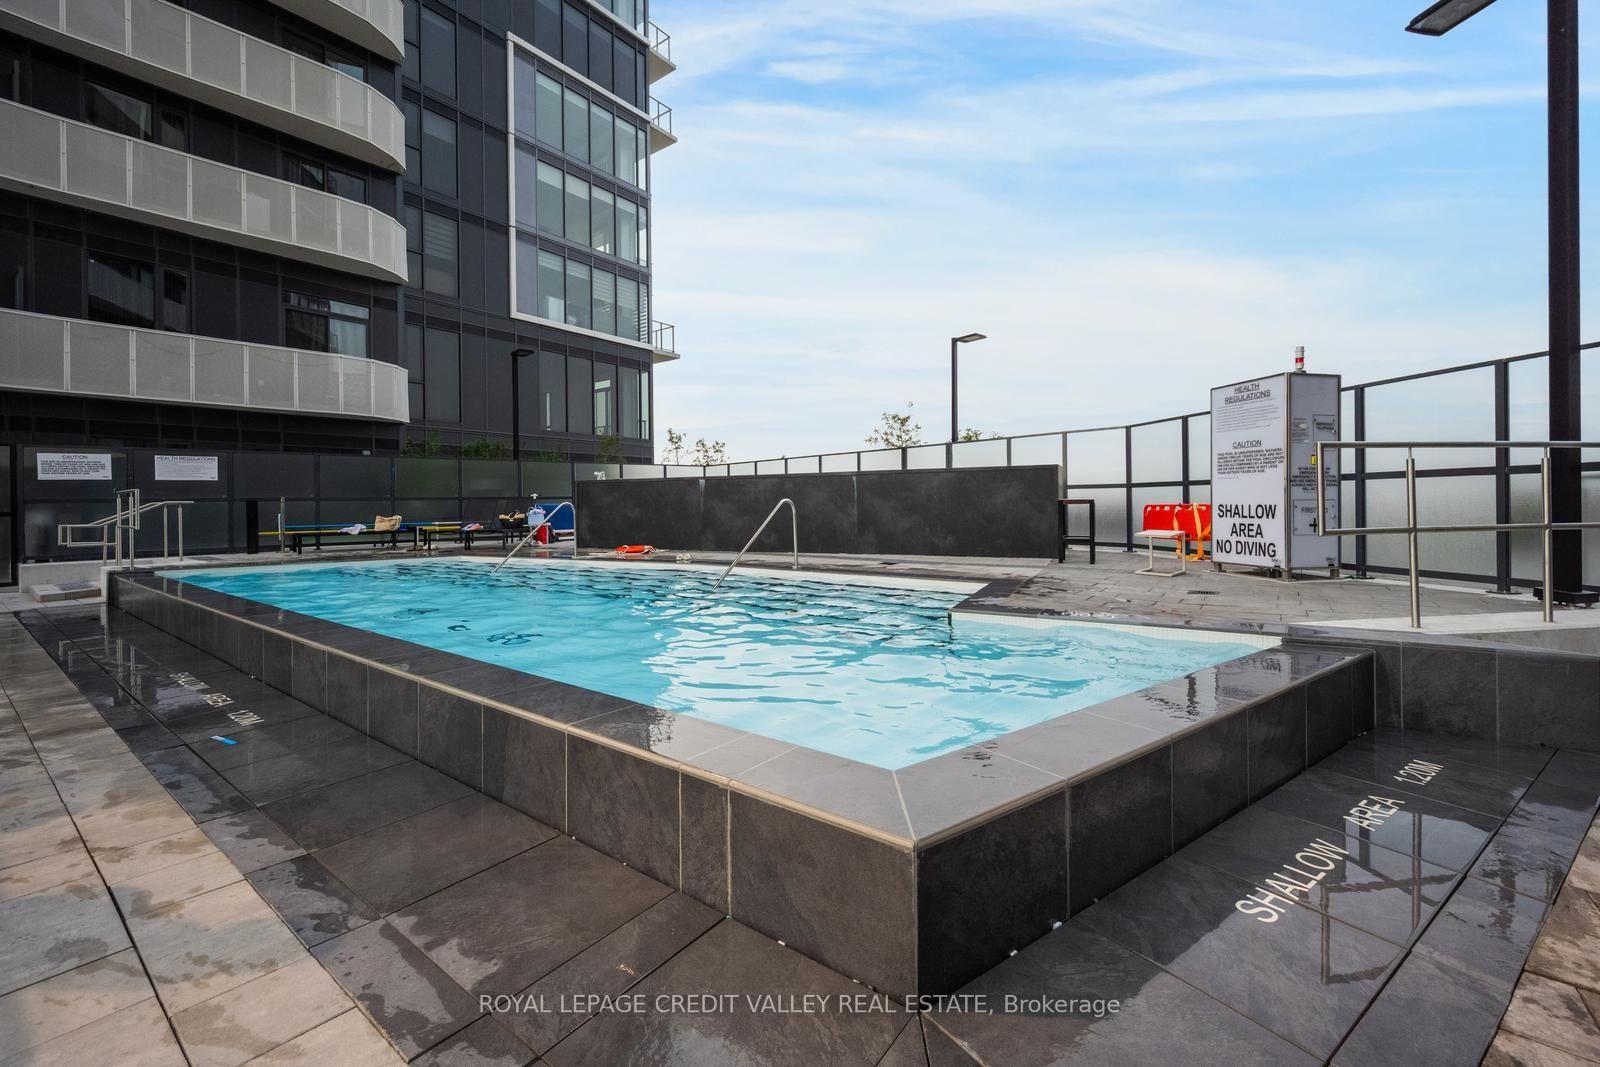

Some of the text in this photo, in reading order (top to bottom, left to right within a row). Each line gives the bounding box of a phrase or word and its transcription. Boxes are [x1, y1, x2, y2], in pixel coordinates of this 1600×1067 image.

[1234, 384, 1260, 394] HEALTH
[1224, 389, 1271, 405] REGULATIONS
[1232, 440, 1262, 449] CAUTION
[1217, 504, 1277, 519] SHALLOW
[1230, 523, 1264, 538] AREA
[1216, 539, 1276, 558] NO DIVING
[1235, 838, 1350, 922] SHALLOW
[1342, 795, 1406, 831] AREA
